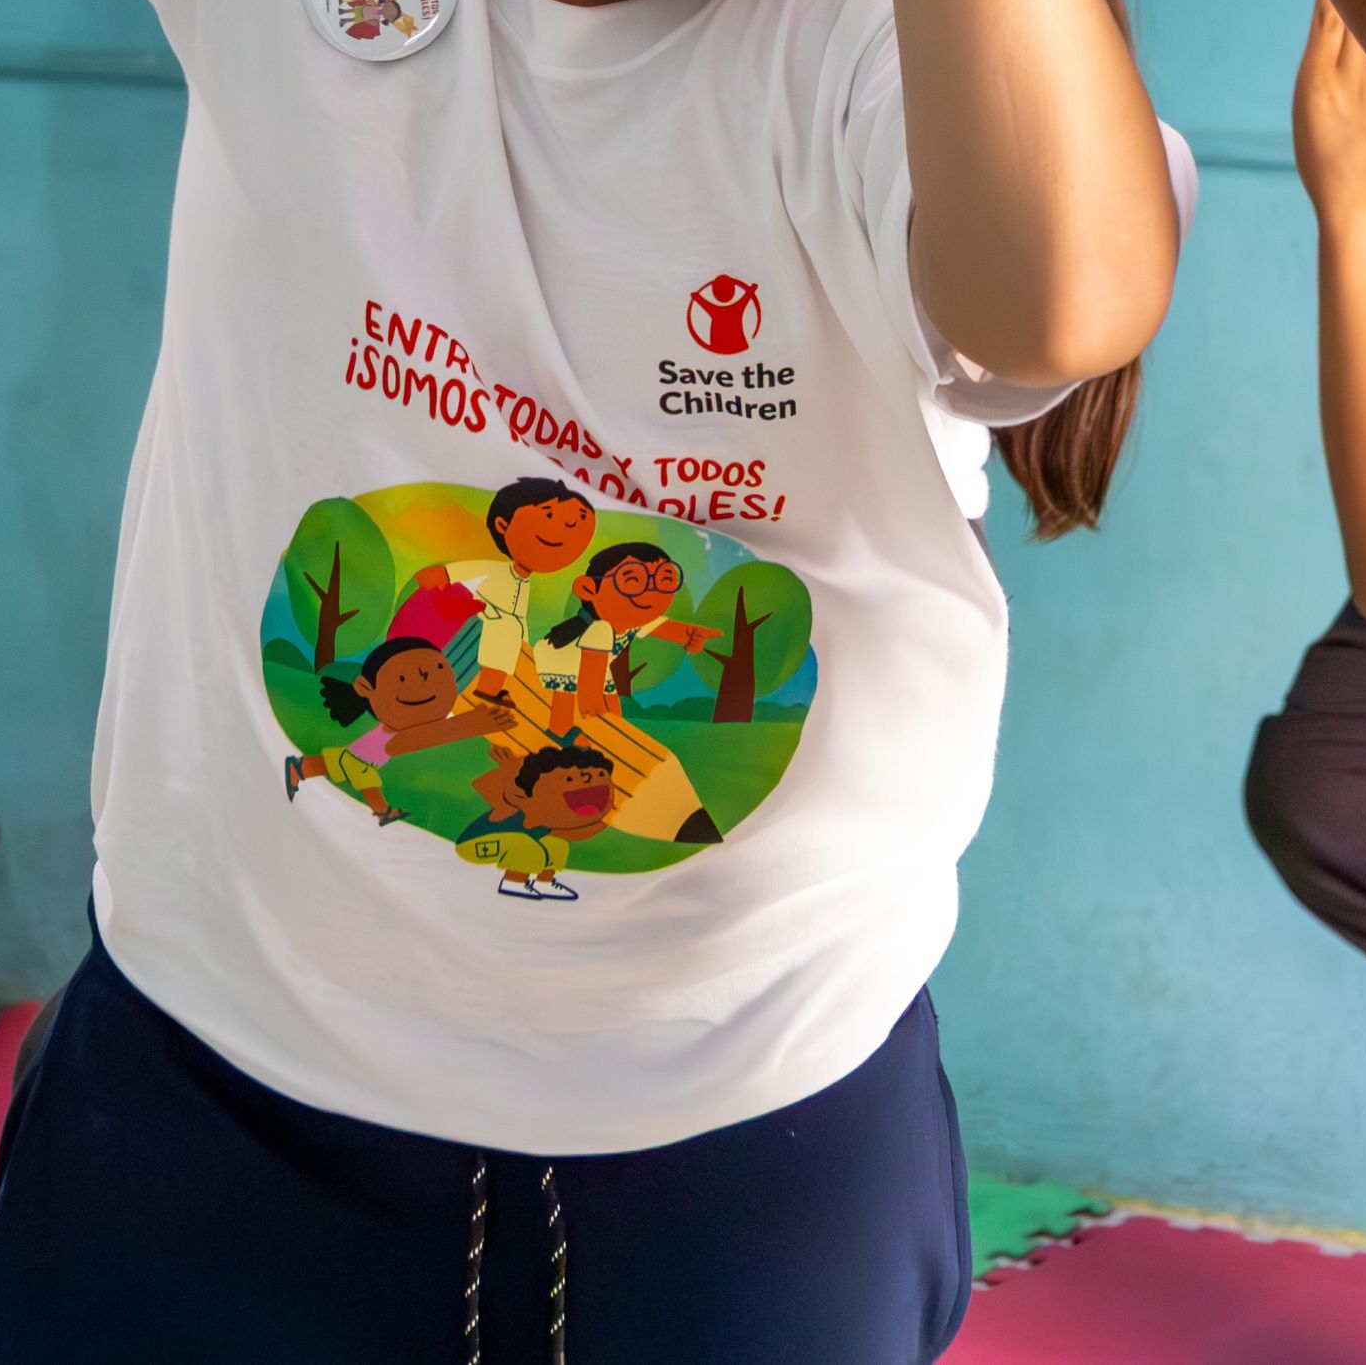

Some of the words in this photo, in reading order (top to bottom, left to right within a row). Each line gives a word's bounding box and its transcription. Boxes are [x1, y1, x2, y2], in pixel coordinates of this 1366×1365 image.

[345, 337, 491, 433] ¡SOMOS
[365, 299, 483, 387] ENTR
[494, 383, 602, 460] TODAS
[654, 457, 766, 488] TODOS
[658, 360, 735, 389] Save
[741, 362, 796, 389] the
[659, 391, 797, 421] Children
